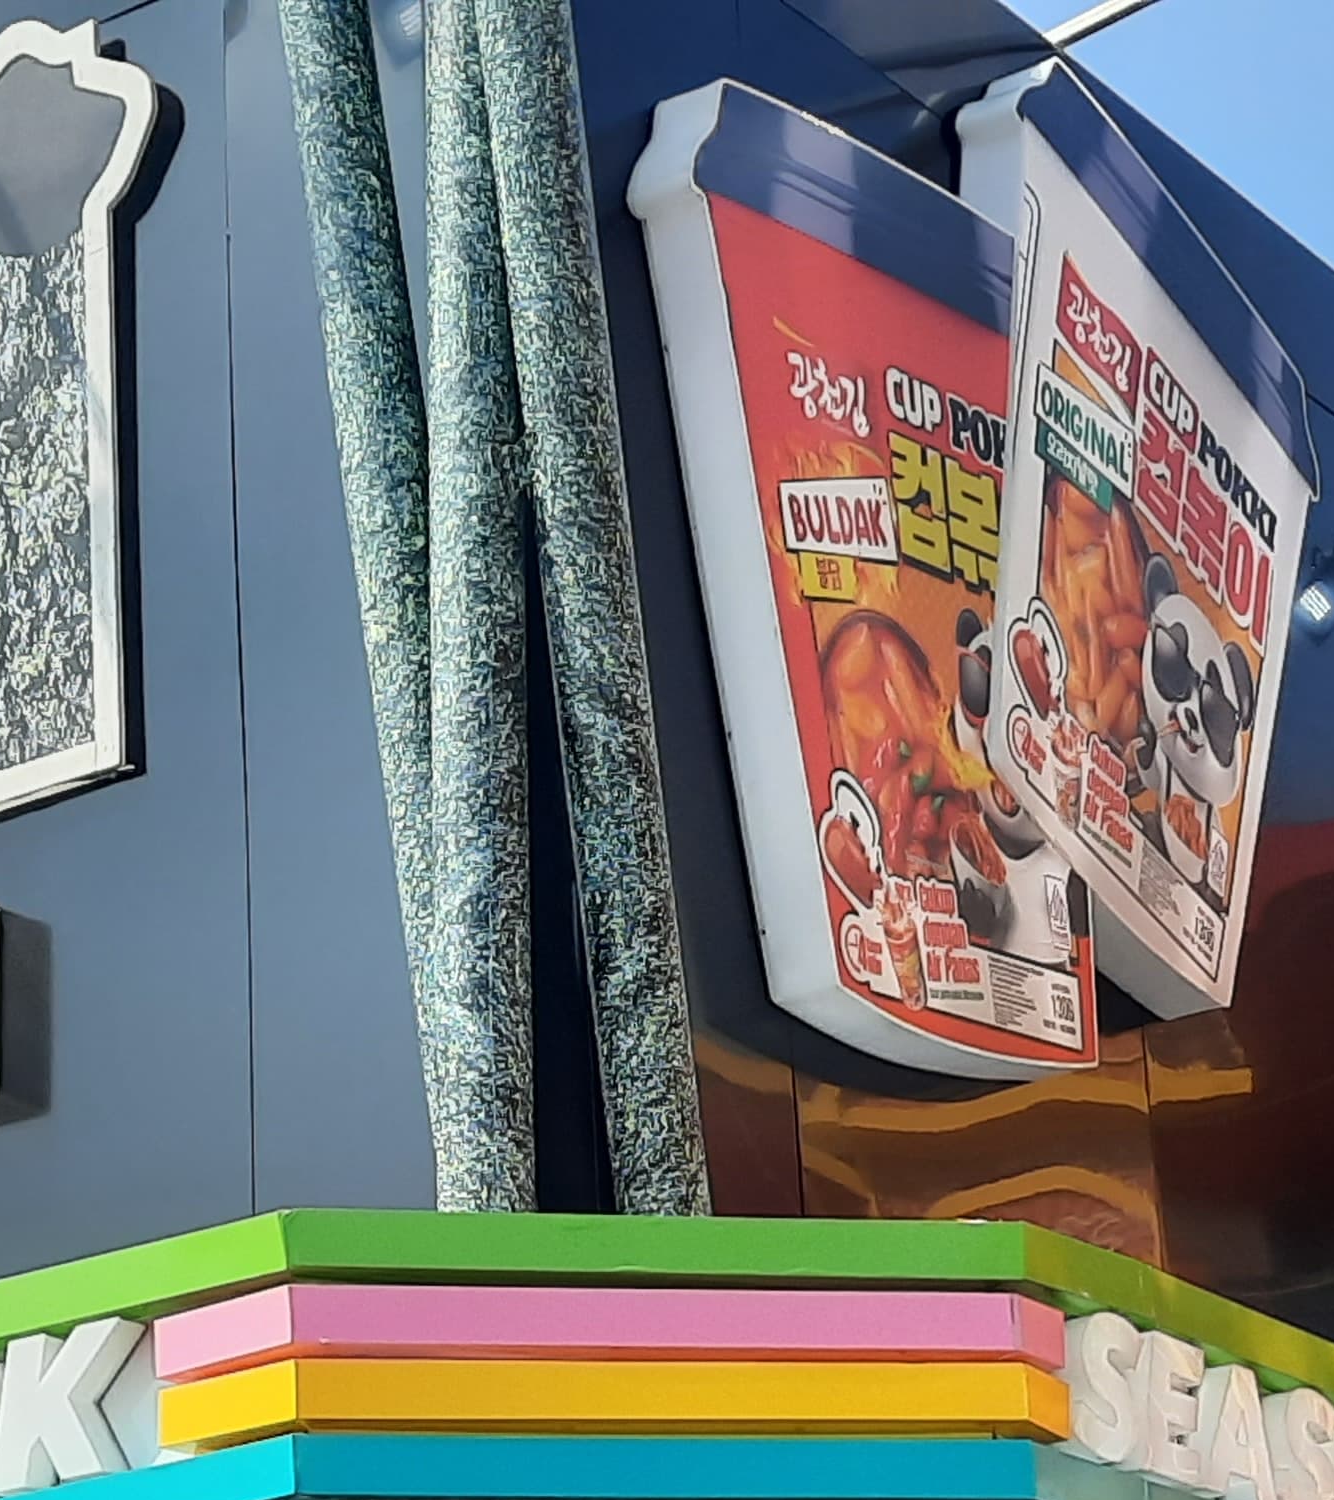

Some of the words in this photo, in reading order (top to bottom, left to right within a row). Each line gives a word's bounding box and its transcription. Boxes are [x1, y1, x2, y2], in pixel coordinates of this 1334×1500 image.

[1067, 281, 1133, 394] 광천김
[786, 349, 871, 438] 광천김
[885, 366, 941, 432] CUP
[948, 396, 1007, 469] POK
[1041, 381, 1129, 484] ORIGINAL
[1150, 360, 1194, 434] CUP
[1198, 421, 1277, 552] POKKI
[787, 490, 888, 548] BULDAK
[889, 431, 1001, 593] 컵볶
